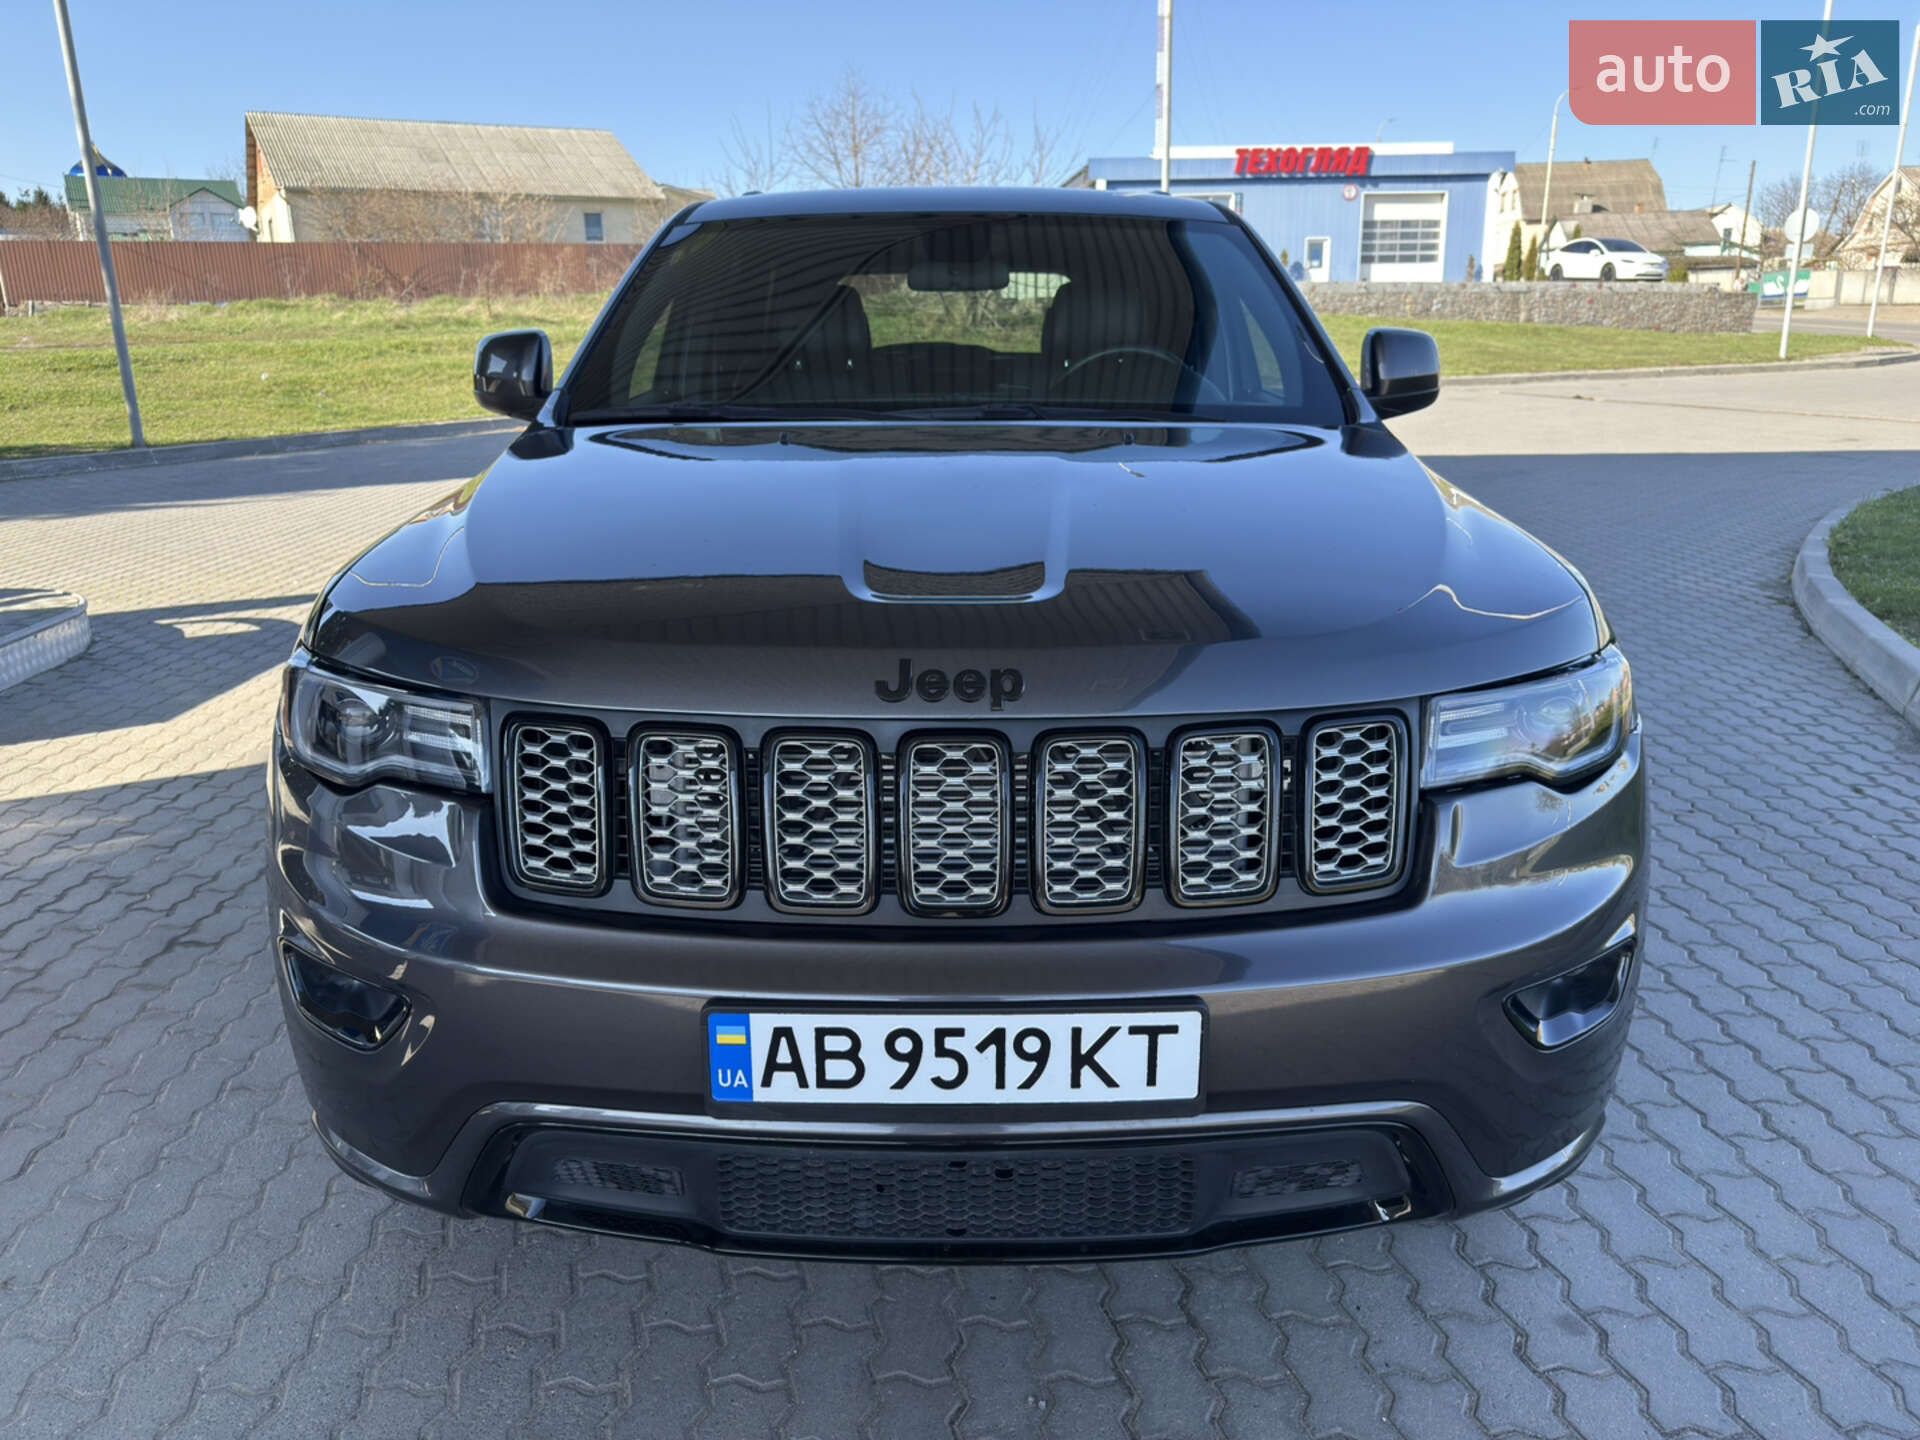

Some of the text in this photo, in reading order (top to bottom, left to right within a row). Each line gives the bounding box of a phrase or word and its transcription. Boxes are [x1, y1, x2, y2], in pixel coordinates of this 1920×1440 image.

[1235, 147, 1370, 176] ТЕХОГЛЯД
[875, 658, 1025, 711] Jeep
[760, 1024, 1181, 1091] AB 9519 KT
[717, 1068, 749, 1089] UA
